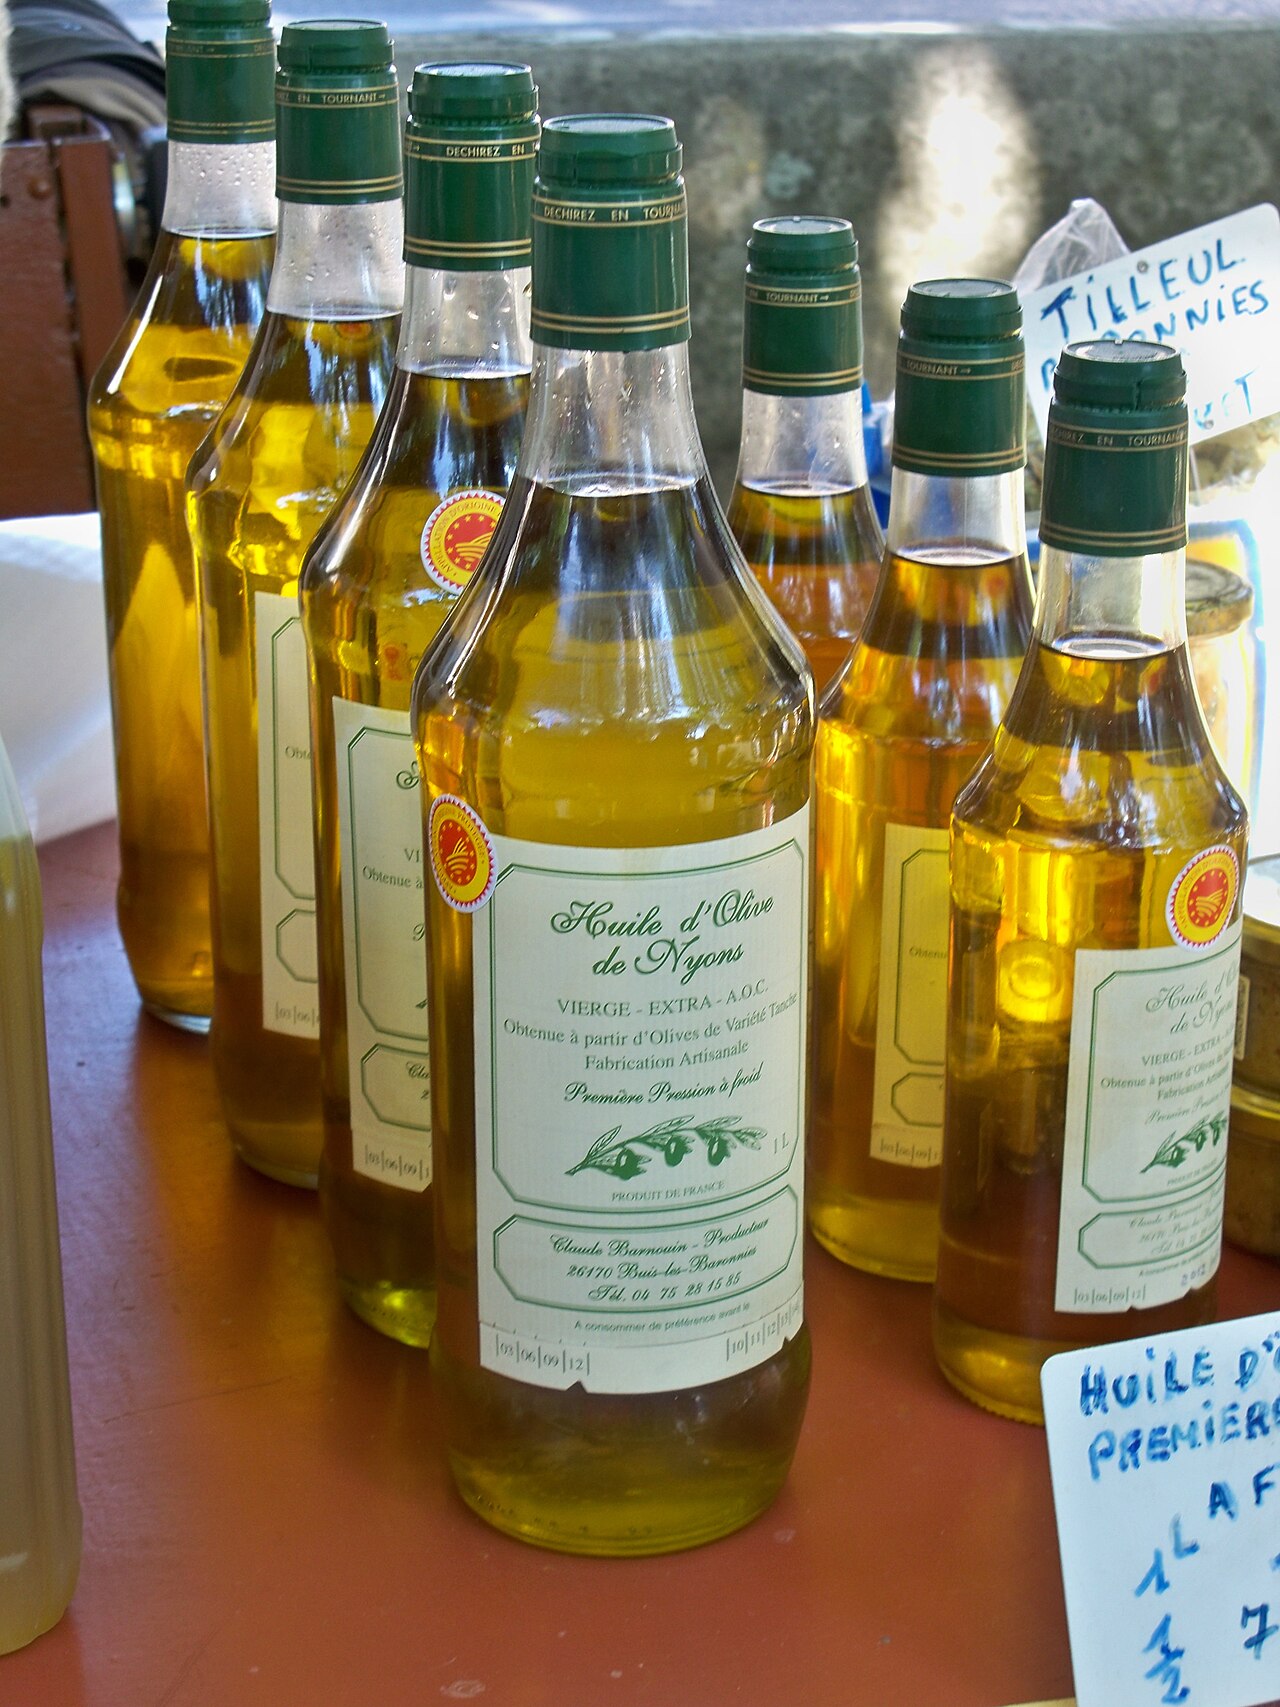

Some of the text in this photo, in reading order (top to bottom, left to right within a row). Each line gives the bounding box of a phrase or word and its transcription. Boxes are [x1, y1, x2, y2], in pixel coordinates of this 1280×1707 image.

[297, 92, 311, 104] EN
[321, 93, 377, 105] TOURNANT
[445, 145, 502, 158] DECHIREZ
[511, 144, 526, 156] EN
[543, 205, 597, 222] DECHIREZ
[610, 209, 630, 222] EN
[766, 291, 819, 304] TOURNANT
[905, 359, 959, 376] TOURNANT
[1096, 436, 1114, 446] EN
[362, 864, 412, 889] Obtenue
[550, 888, 774, 940] Huile d'Olive
[592, 934, 745, 986] de Nyons
[557, 998, 631, 1017] VIERGE
[649, 994, 712, 1017] EXTRA
[725, 977, 769, 1006] A.O.C.
[1145, 980, 1208, 1013] Huile
[503, 1017, 565, 1043] Obtenue
[570, 1028, 579, 1045] à
[584, 1031, 628, 1049] partir
[632, 1027, 700, 1047] d'Olives
[703, 1022, 721, 1037] de
[726, 1006, 768, 1033] Variété
[1169, 1011, 1189, 1035] de
[584, 1039, 751, 1071] Fabrication Artisanale
[1142, 1048, 1187, 1067] VIERGE
[563, 1061, 765, 1105] Première Pression à froid
[1100, 1074, 1146, 1089] Obtenue
[611, 1180, 725, 1202] PRODUIT DE FRANCE
[550, 1233, 603, 1257] Claude
[703, 1217, 770, 1249] Producteur
[565, 1263, 614, 1280] 26170
[629, 1288, 651, 1302] 04
[659, 1285, 679, 1301] 75
[684, 1281, 704, 1298] 28
[707, 1277, 723, 1293] 15
[725, 1271, 743, 1289] 85
[584, 1321, 646, 1333] consommer
[648, 1320, 662, 1331] de
[568, 1357, 584, 1371] 12
[1079, 1345, 1215, 1417] HUiLE
[1208, 1481, 1238, 1521] A
